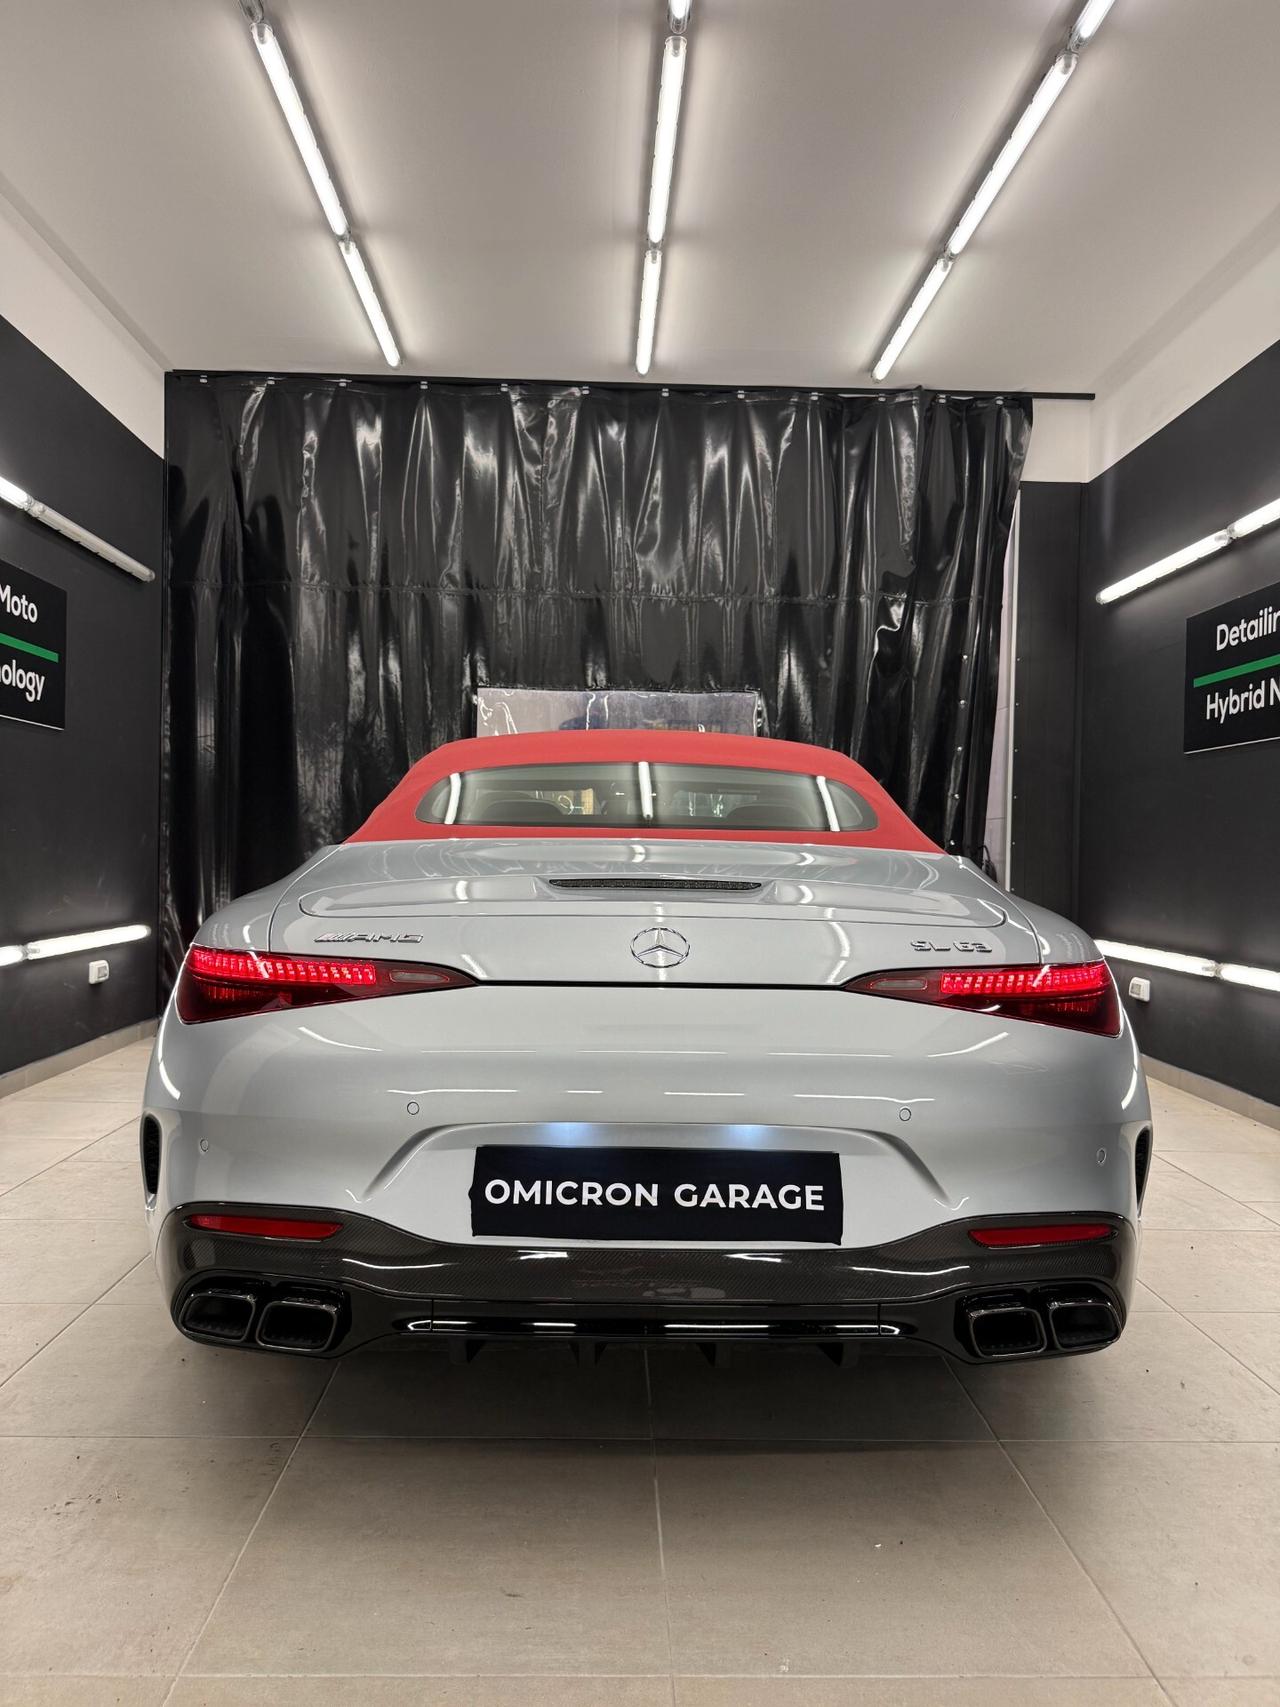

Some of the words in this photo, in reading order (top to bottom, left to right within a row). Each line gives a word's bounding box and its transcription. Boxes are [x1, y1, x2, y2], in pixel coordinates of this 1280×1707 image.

[0, 584, 38, 623] Moto
[0, 659, 45, 702] ology
[1206, 680, 1265, 724] Hybrid
[344, 931, 424, 943] AMG
[910, 939, 952, 952] SL
[484, 1179, 658, 1207] OMICRON
[674, 1183, 825, 1211] GARAGE
